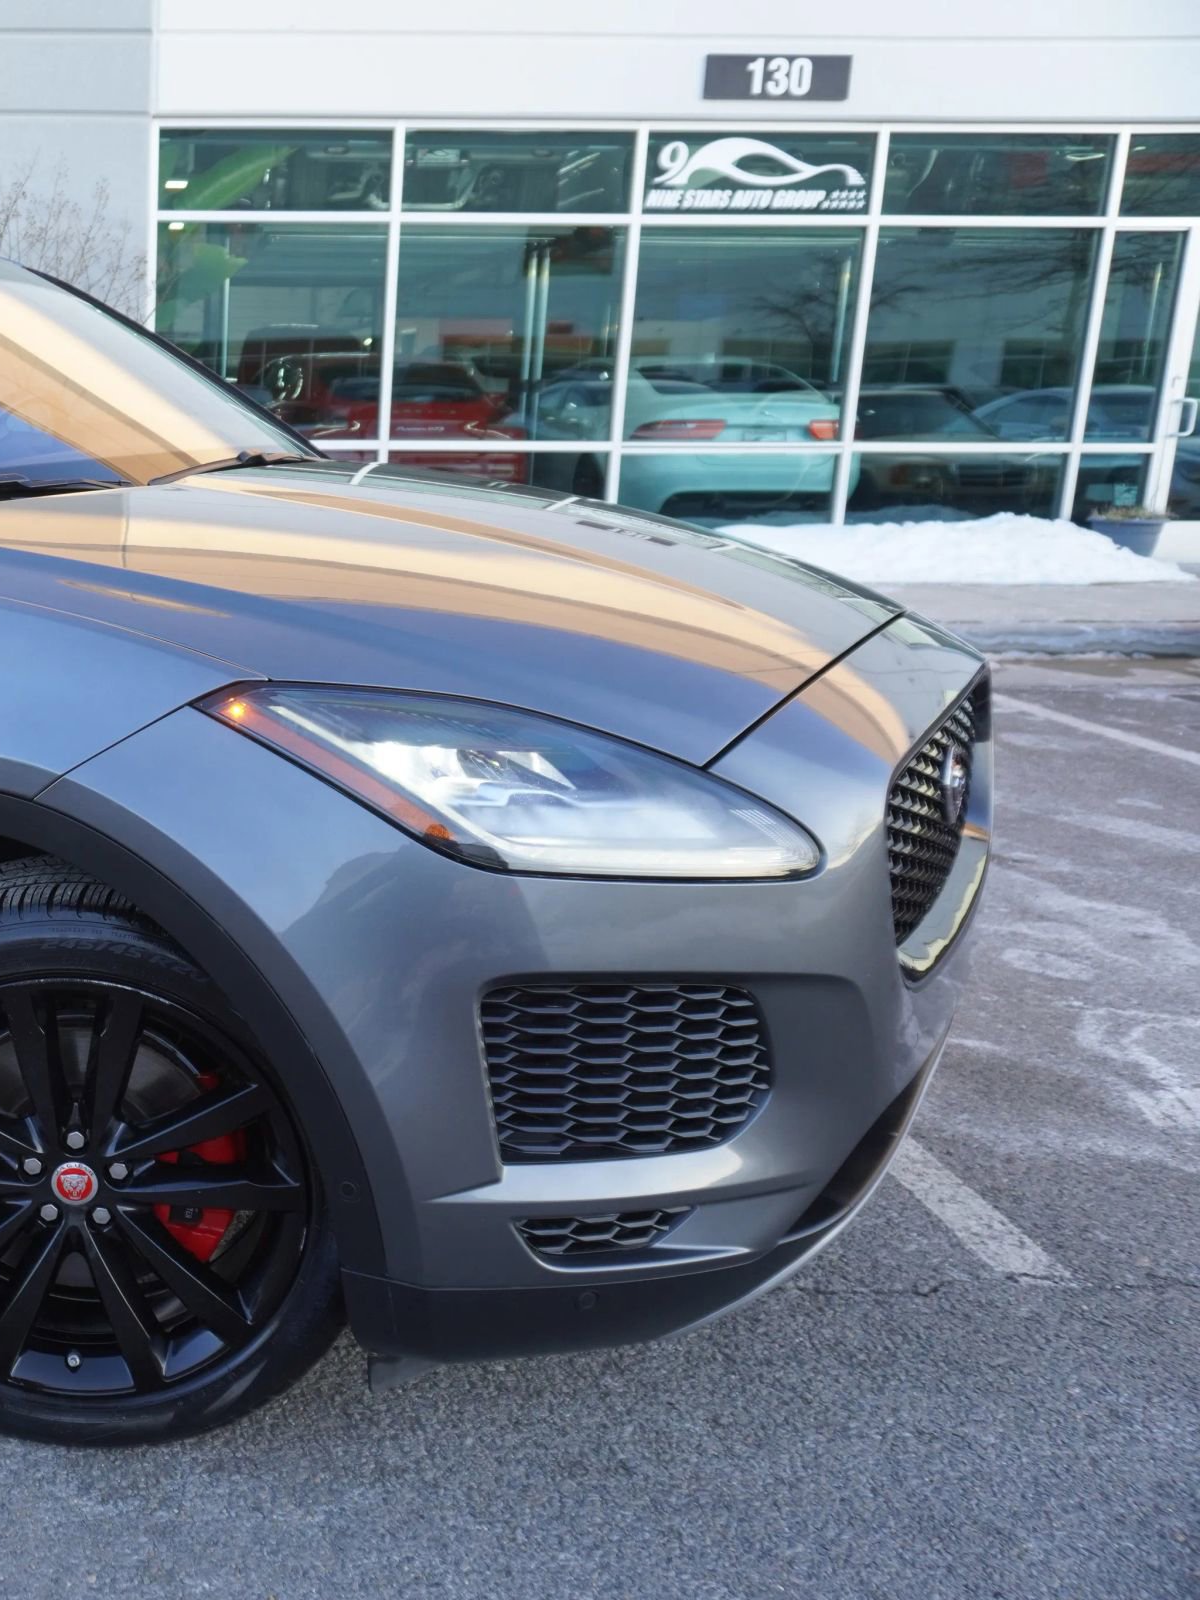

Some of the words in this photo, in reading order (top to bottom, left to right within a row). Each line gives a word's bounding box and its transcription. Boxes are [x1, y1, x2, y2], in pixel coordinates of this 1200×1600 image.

[746, 57, 814, 96] 130
[652, 141, 689, 185] 9
[645, 189, 683, 209] NINE
[683, 189, 732, 209] STARS
[730, 189, 770, 209] AUTO
[772, 189, 824, 209] GROUP
[41, 938, 144, 959] 245/45
